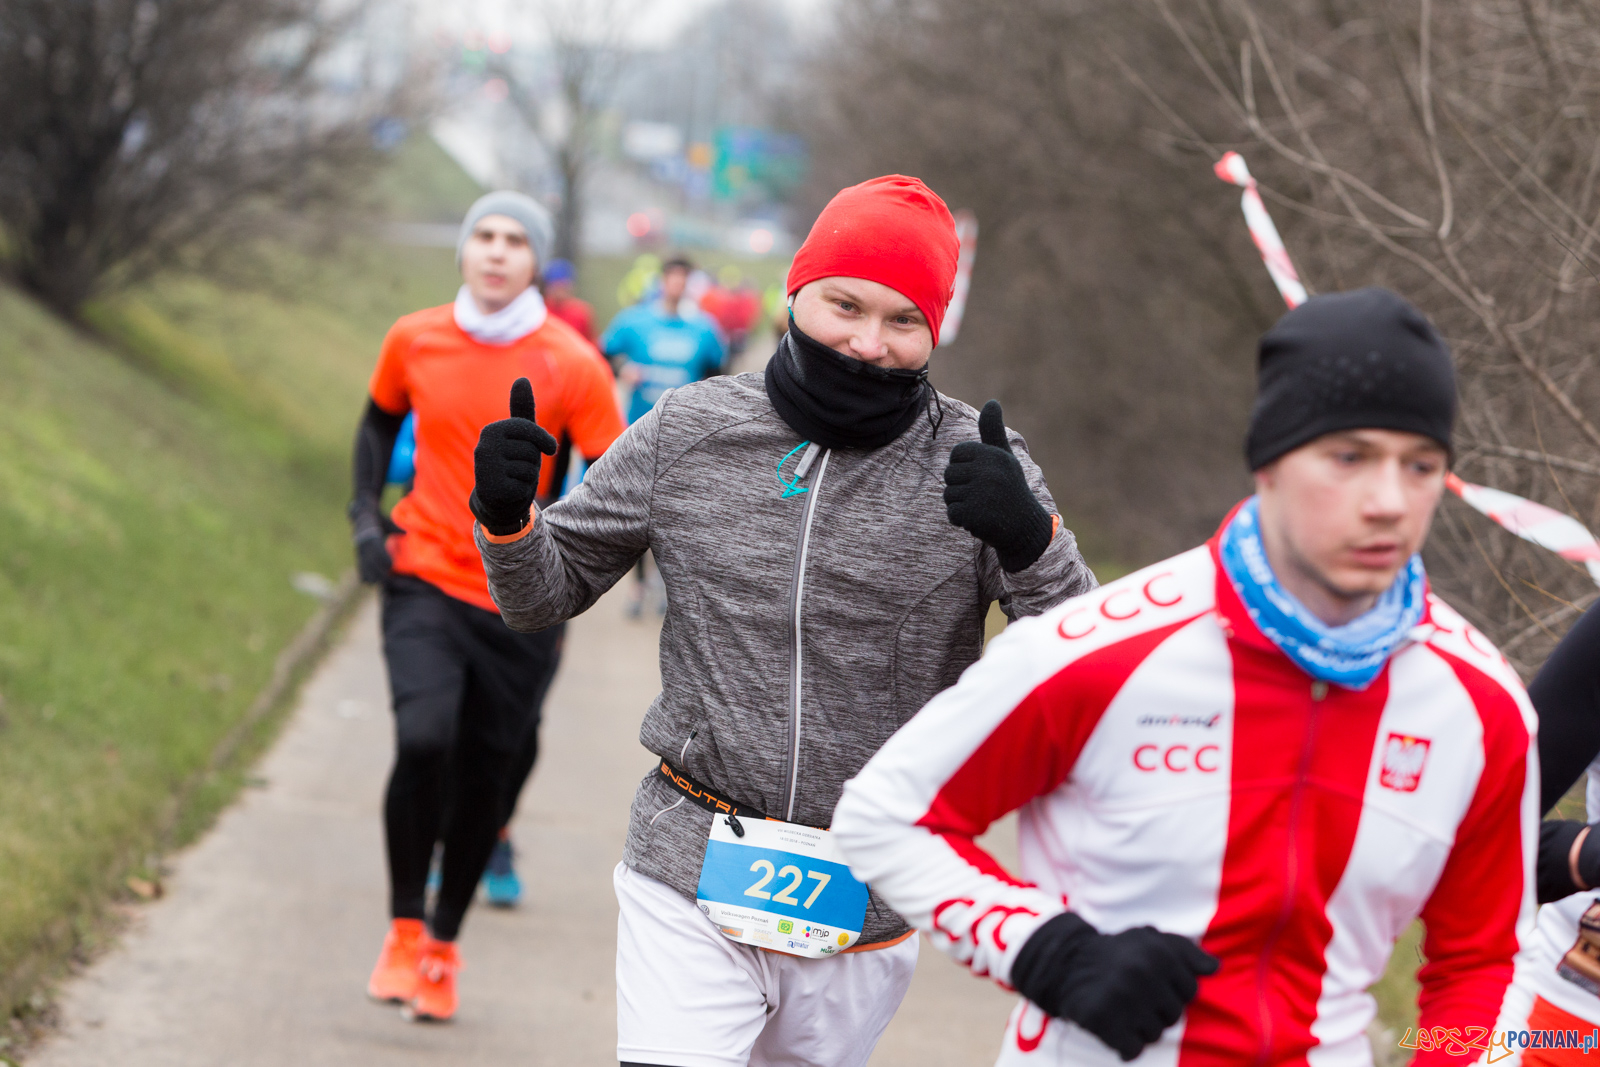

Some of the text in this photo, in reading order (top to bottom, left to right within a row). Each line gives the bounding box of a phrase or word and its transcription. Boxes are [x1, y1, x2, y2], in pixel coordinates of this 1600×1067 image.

[1057, 572, 1183, 640] CCC
[1132, 743, 1220, 773] CCC
[743, 859, 832, 910] 227
[721, 910, 751, 920] Volkswagen
[751, 915, 769, 924] Poznań
[812, 927, 830, 938] mjp
